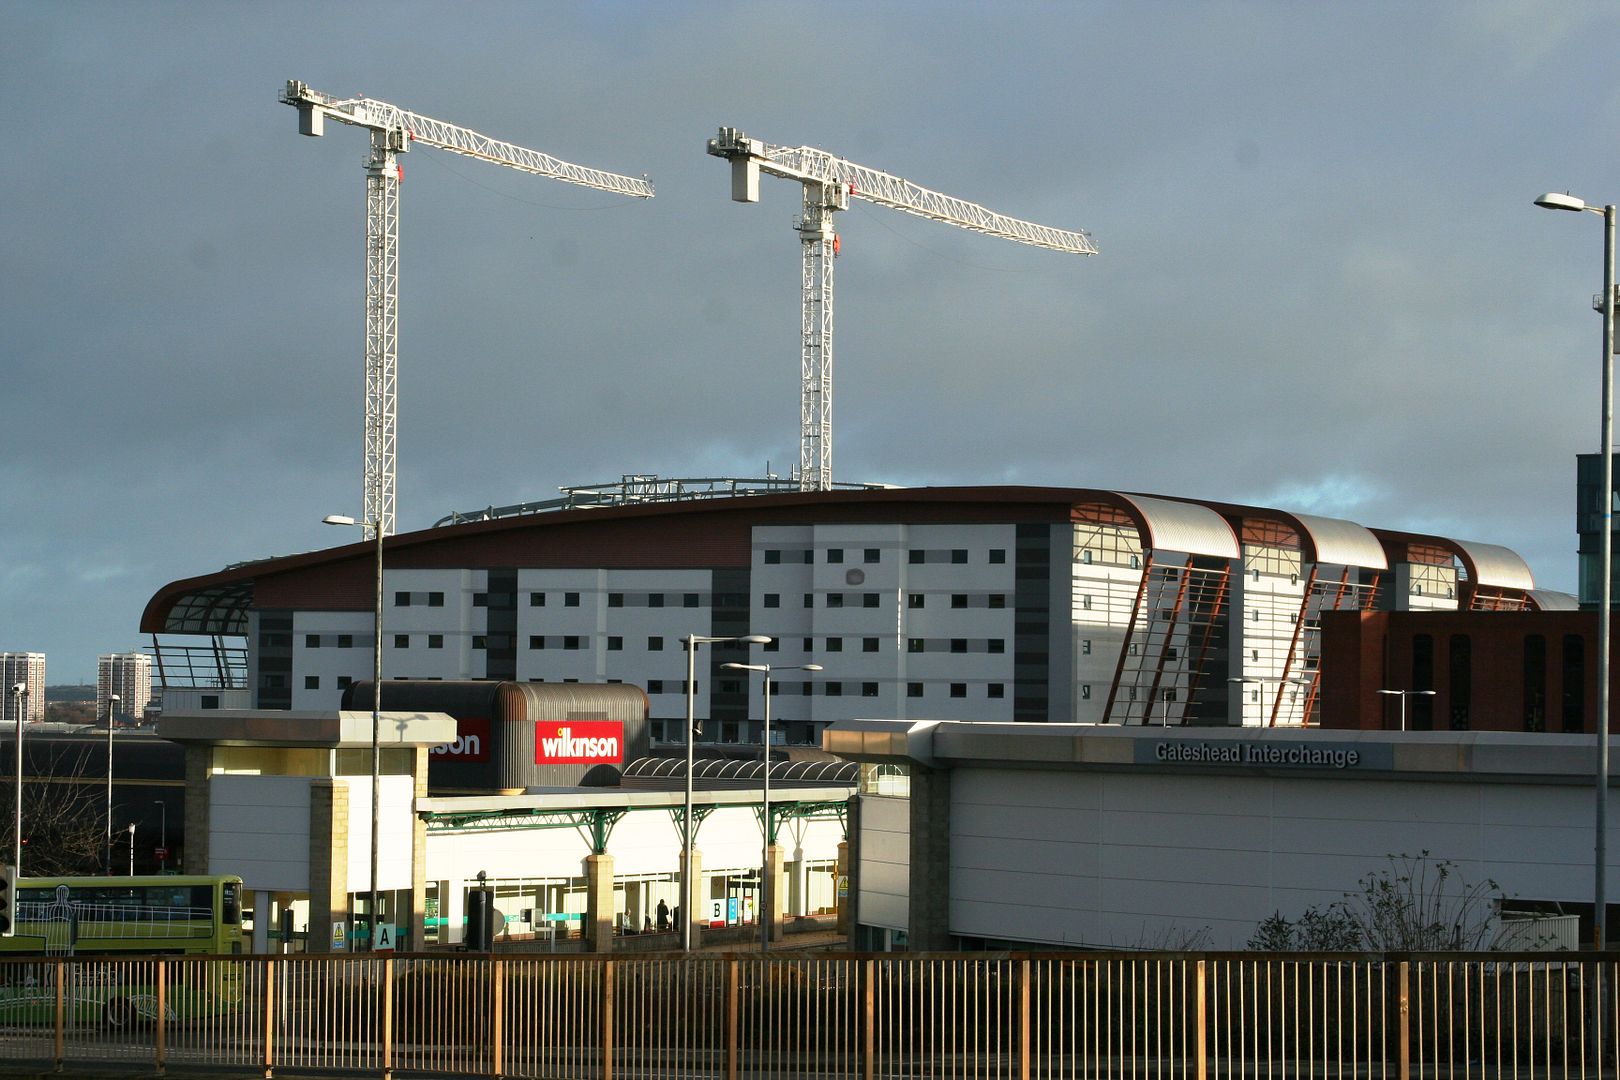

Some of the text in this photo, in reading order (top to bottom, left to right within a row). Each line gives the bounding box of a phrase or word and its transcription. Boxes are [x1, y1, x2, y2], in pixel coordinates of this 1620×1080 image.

[430, 735, 480, 755] son
[542, 728, 617, 757] wilkinson
[1155, 742, 1359, 768] Gateshead Interchange
[714, 903, 721, 917] B
[380, 928, 389, 945] A
